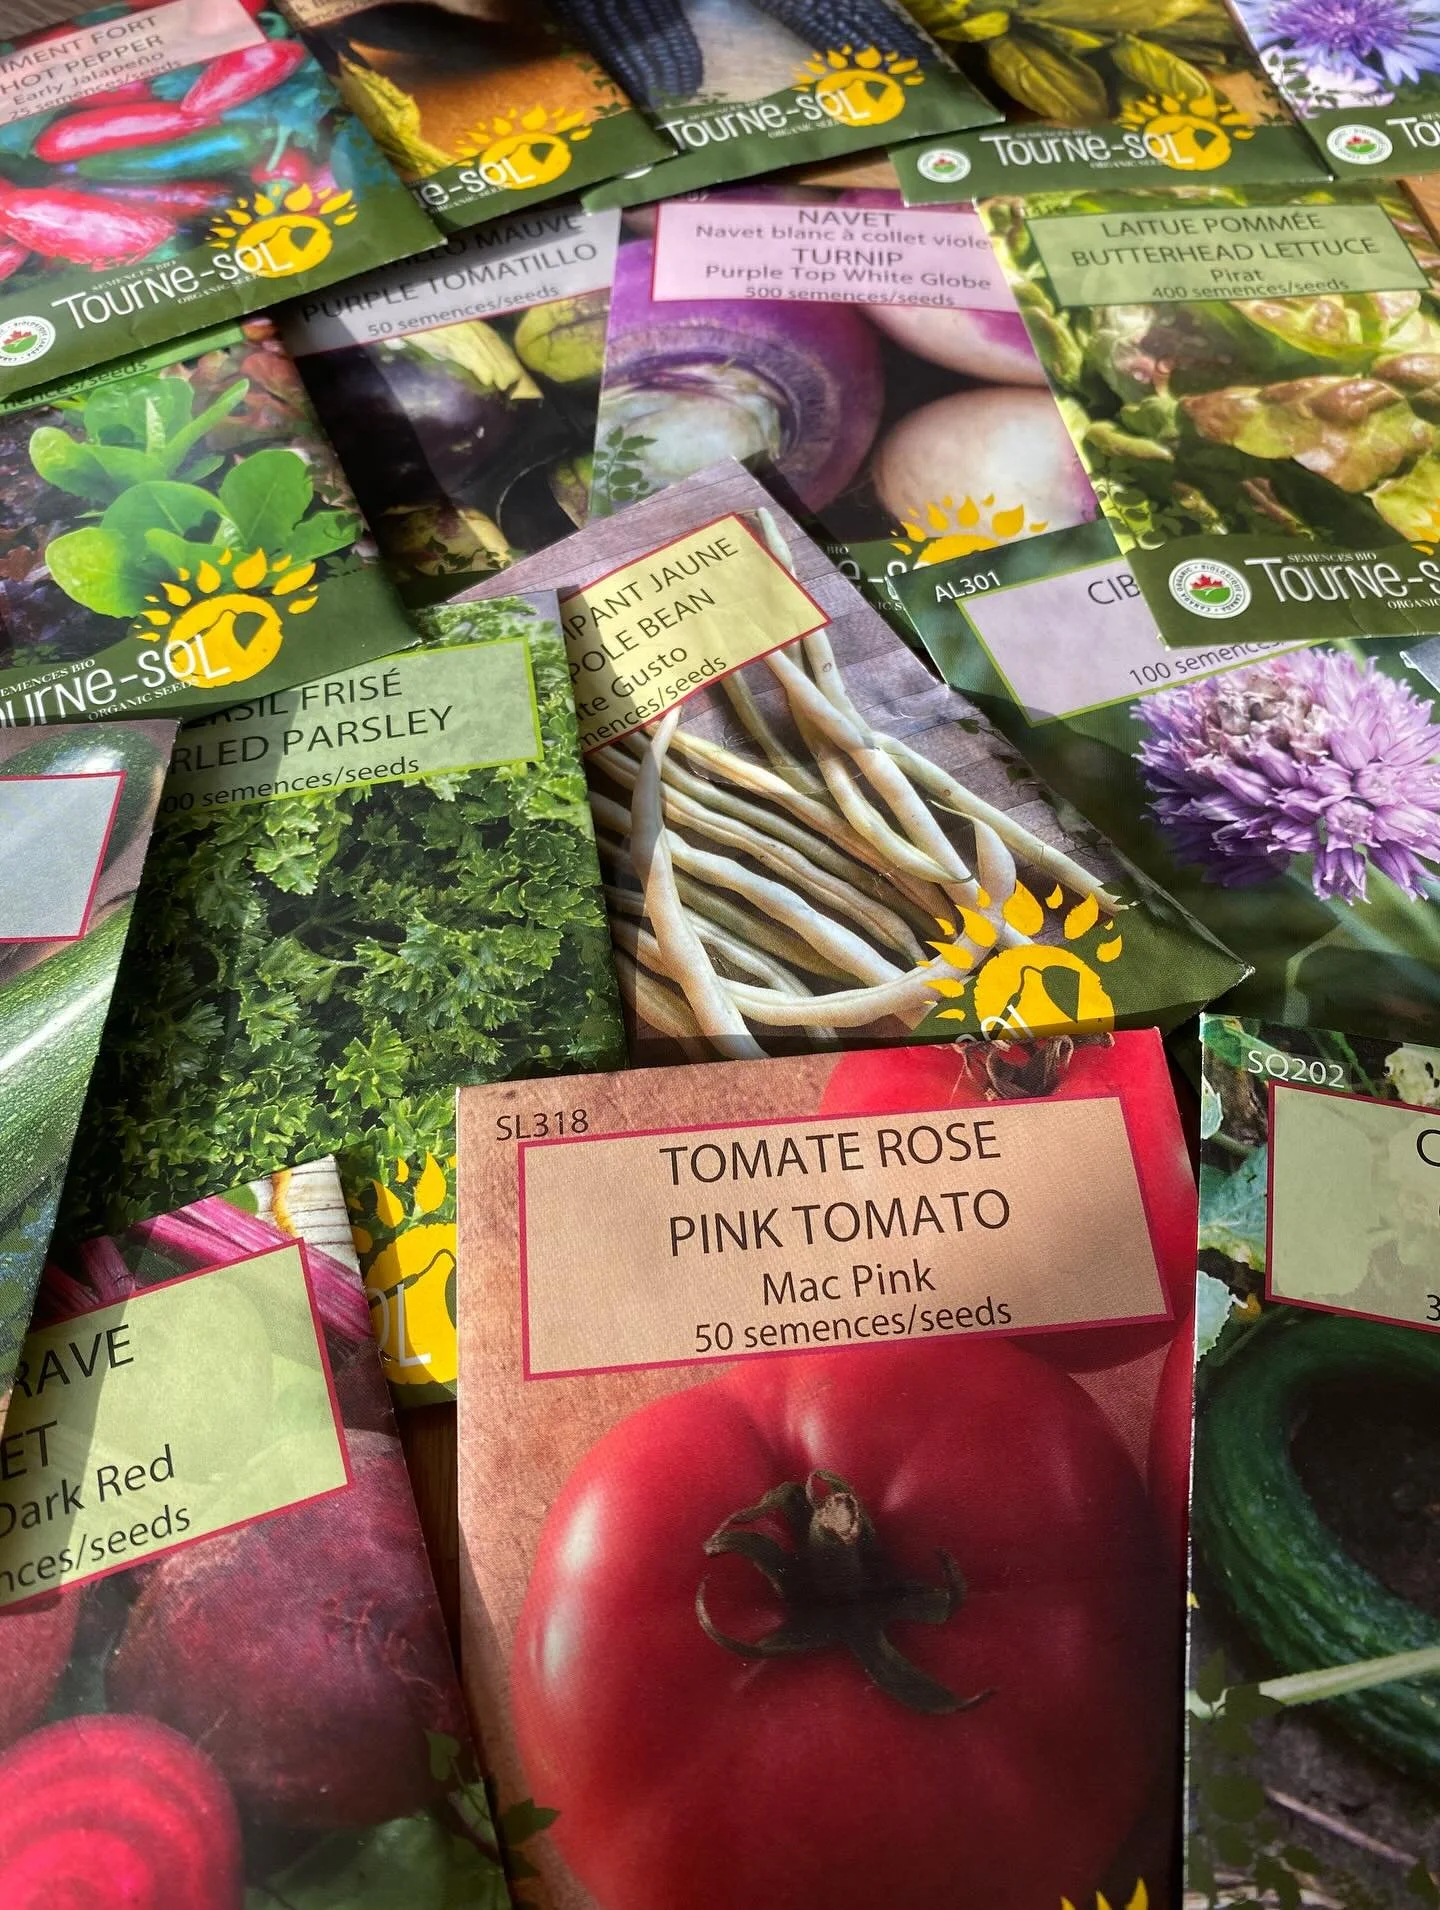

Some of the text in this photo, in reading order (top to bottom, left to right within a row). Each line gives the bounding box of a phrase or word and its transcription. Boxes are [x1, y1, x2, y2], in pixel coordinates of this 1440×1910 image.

[91, 15, 157, 45] FORT
[0, 34, 165, 95] HOT PEPPER
[13, 83, 64, 106] Early
[474, 213, 582, 248] MAUVE
[798, 209, 897, 228] NAVET
[1100, 210, 1326, 239] LAITUE POMMÉE
[695, 225, 764, 240] Navet
[771, 226, 835, 242] blanc
[859, 230, 926, 246] collet
[932, 234, 992, 250] viole
[1070, 236, 1381, 268] BUTTERHEAD LETTUCE
[791, 247, 904, 267] TURNIP
[301, 283, 419, 323] PURPLE
[427, 242, 598, 295] TOMATILLO
[705, 264, 992, 291] Purple Top White Globe
[1151, 277, 1350, 300] 400 semences/seeds
[1209, 267, 1265, 283] Pirat
[367, 284, 560, 337] 50 semences/seeds
[745, 286, 955, 307] 500 semences/seeds
[649, 536, 740, 593] JAUNE
[1287, 551, 1378, 563] SEMENCES BIO
[934, 570, 1001, 603] AL301
[1087, 573, 1141, 605] CIB
[636, 587, 716, 639] BEAN
[70, 658, 96, 674] BIO
[610, 646, 688, 699] Gusto
[1128, 641, 1285, 686] 100 semenc
[88, 692, 153, 721] ORGANIC
[183, 667, 403, 728] SIL FRISÉ
[169, 705, 454, 775] RLED PARSLEY
[201, 755, 420, 808] semences/seeds
[1247, 1050, 1345, 1089] SQ202
[496, 1108, 589, 1142] SL318
[659, 1120, 1001, 1187] TOMATE ROSE
[668, 1189, 1012, 1258] PINK TOMATO
[760, 1258, 936, 1307] Mac Pink
[693, 1296, 1013, 1354] 50 semences/seeds
[96, 1443, 175, 1502] Red
